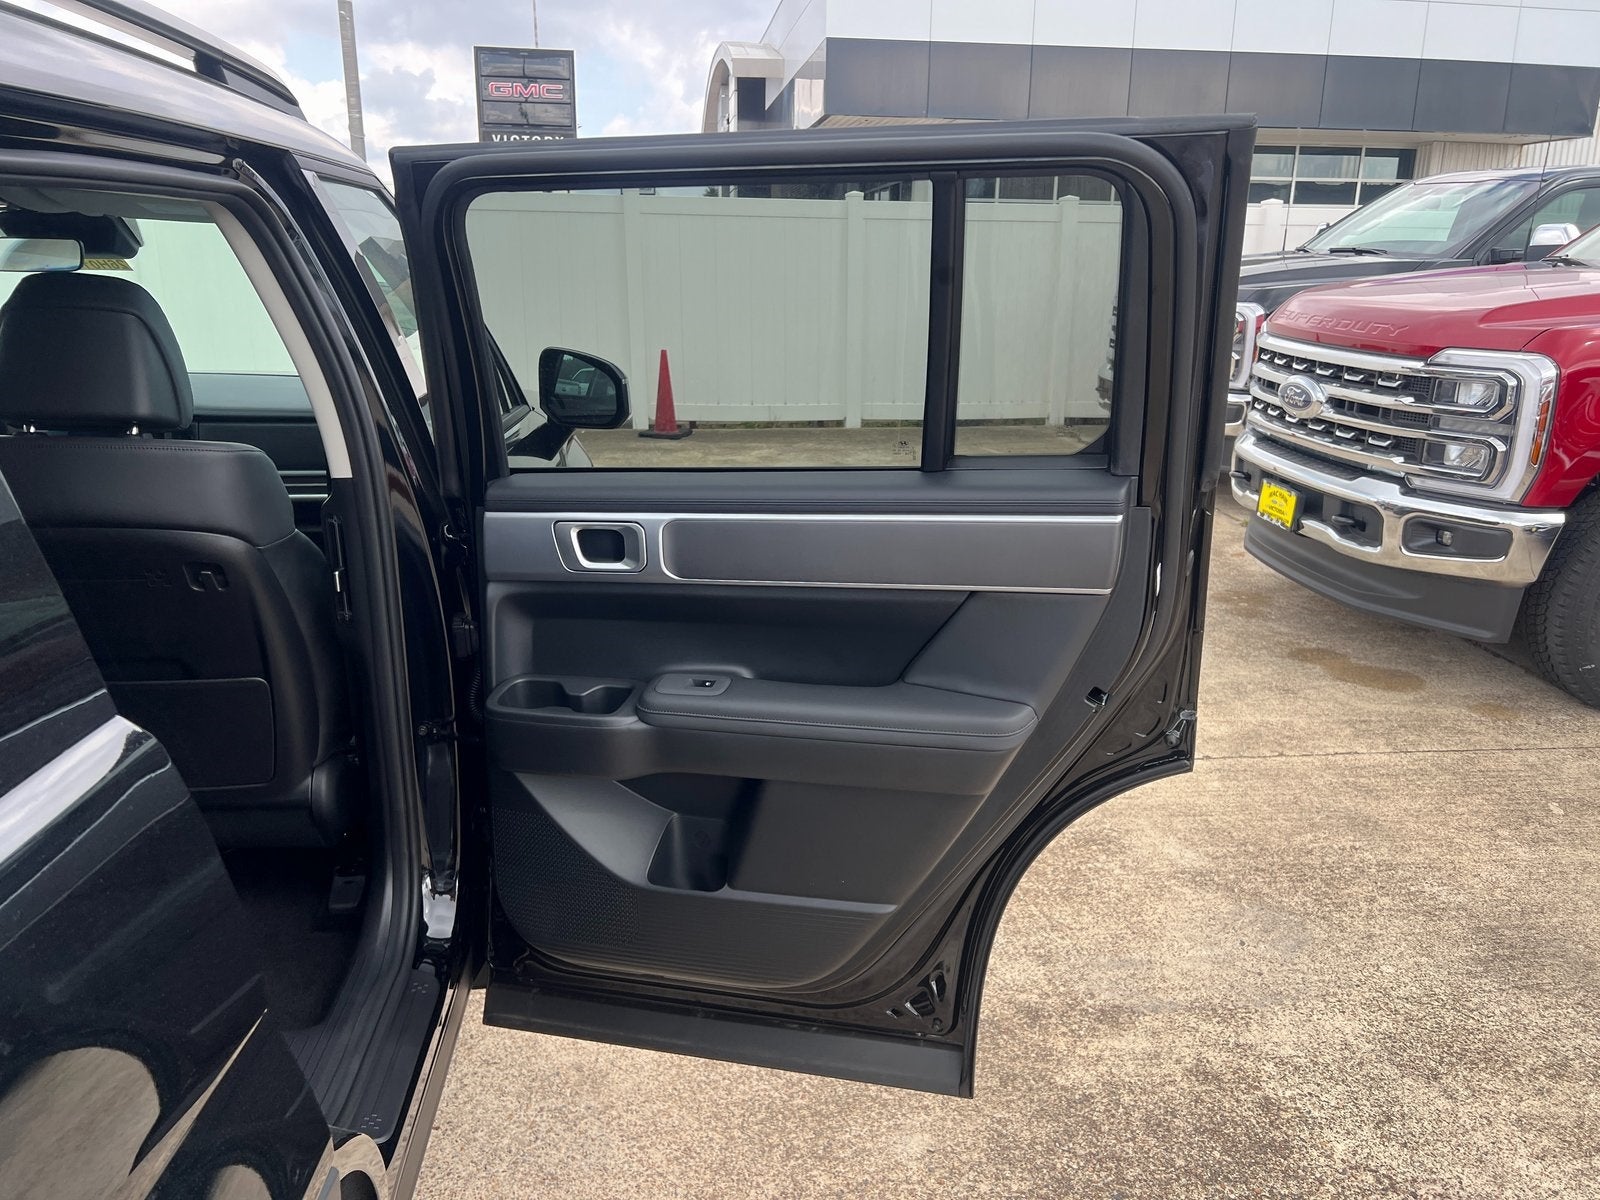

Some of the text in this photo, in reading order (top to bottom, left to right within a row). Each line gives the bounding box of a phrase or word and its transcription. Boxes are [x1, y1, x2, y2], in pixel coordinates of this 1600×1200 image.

[489, 82, 563, 99] GMC
[491, 134, 564, 142] VICT
[1279, 309, 1409, 337] SUPER DUTY
[1285, 386, 1306, 407] Ford
